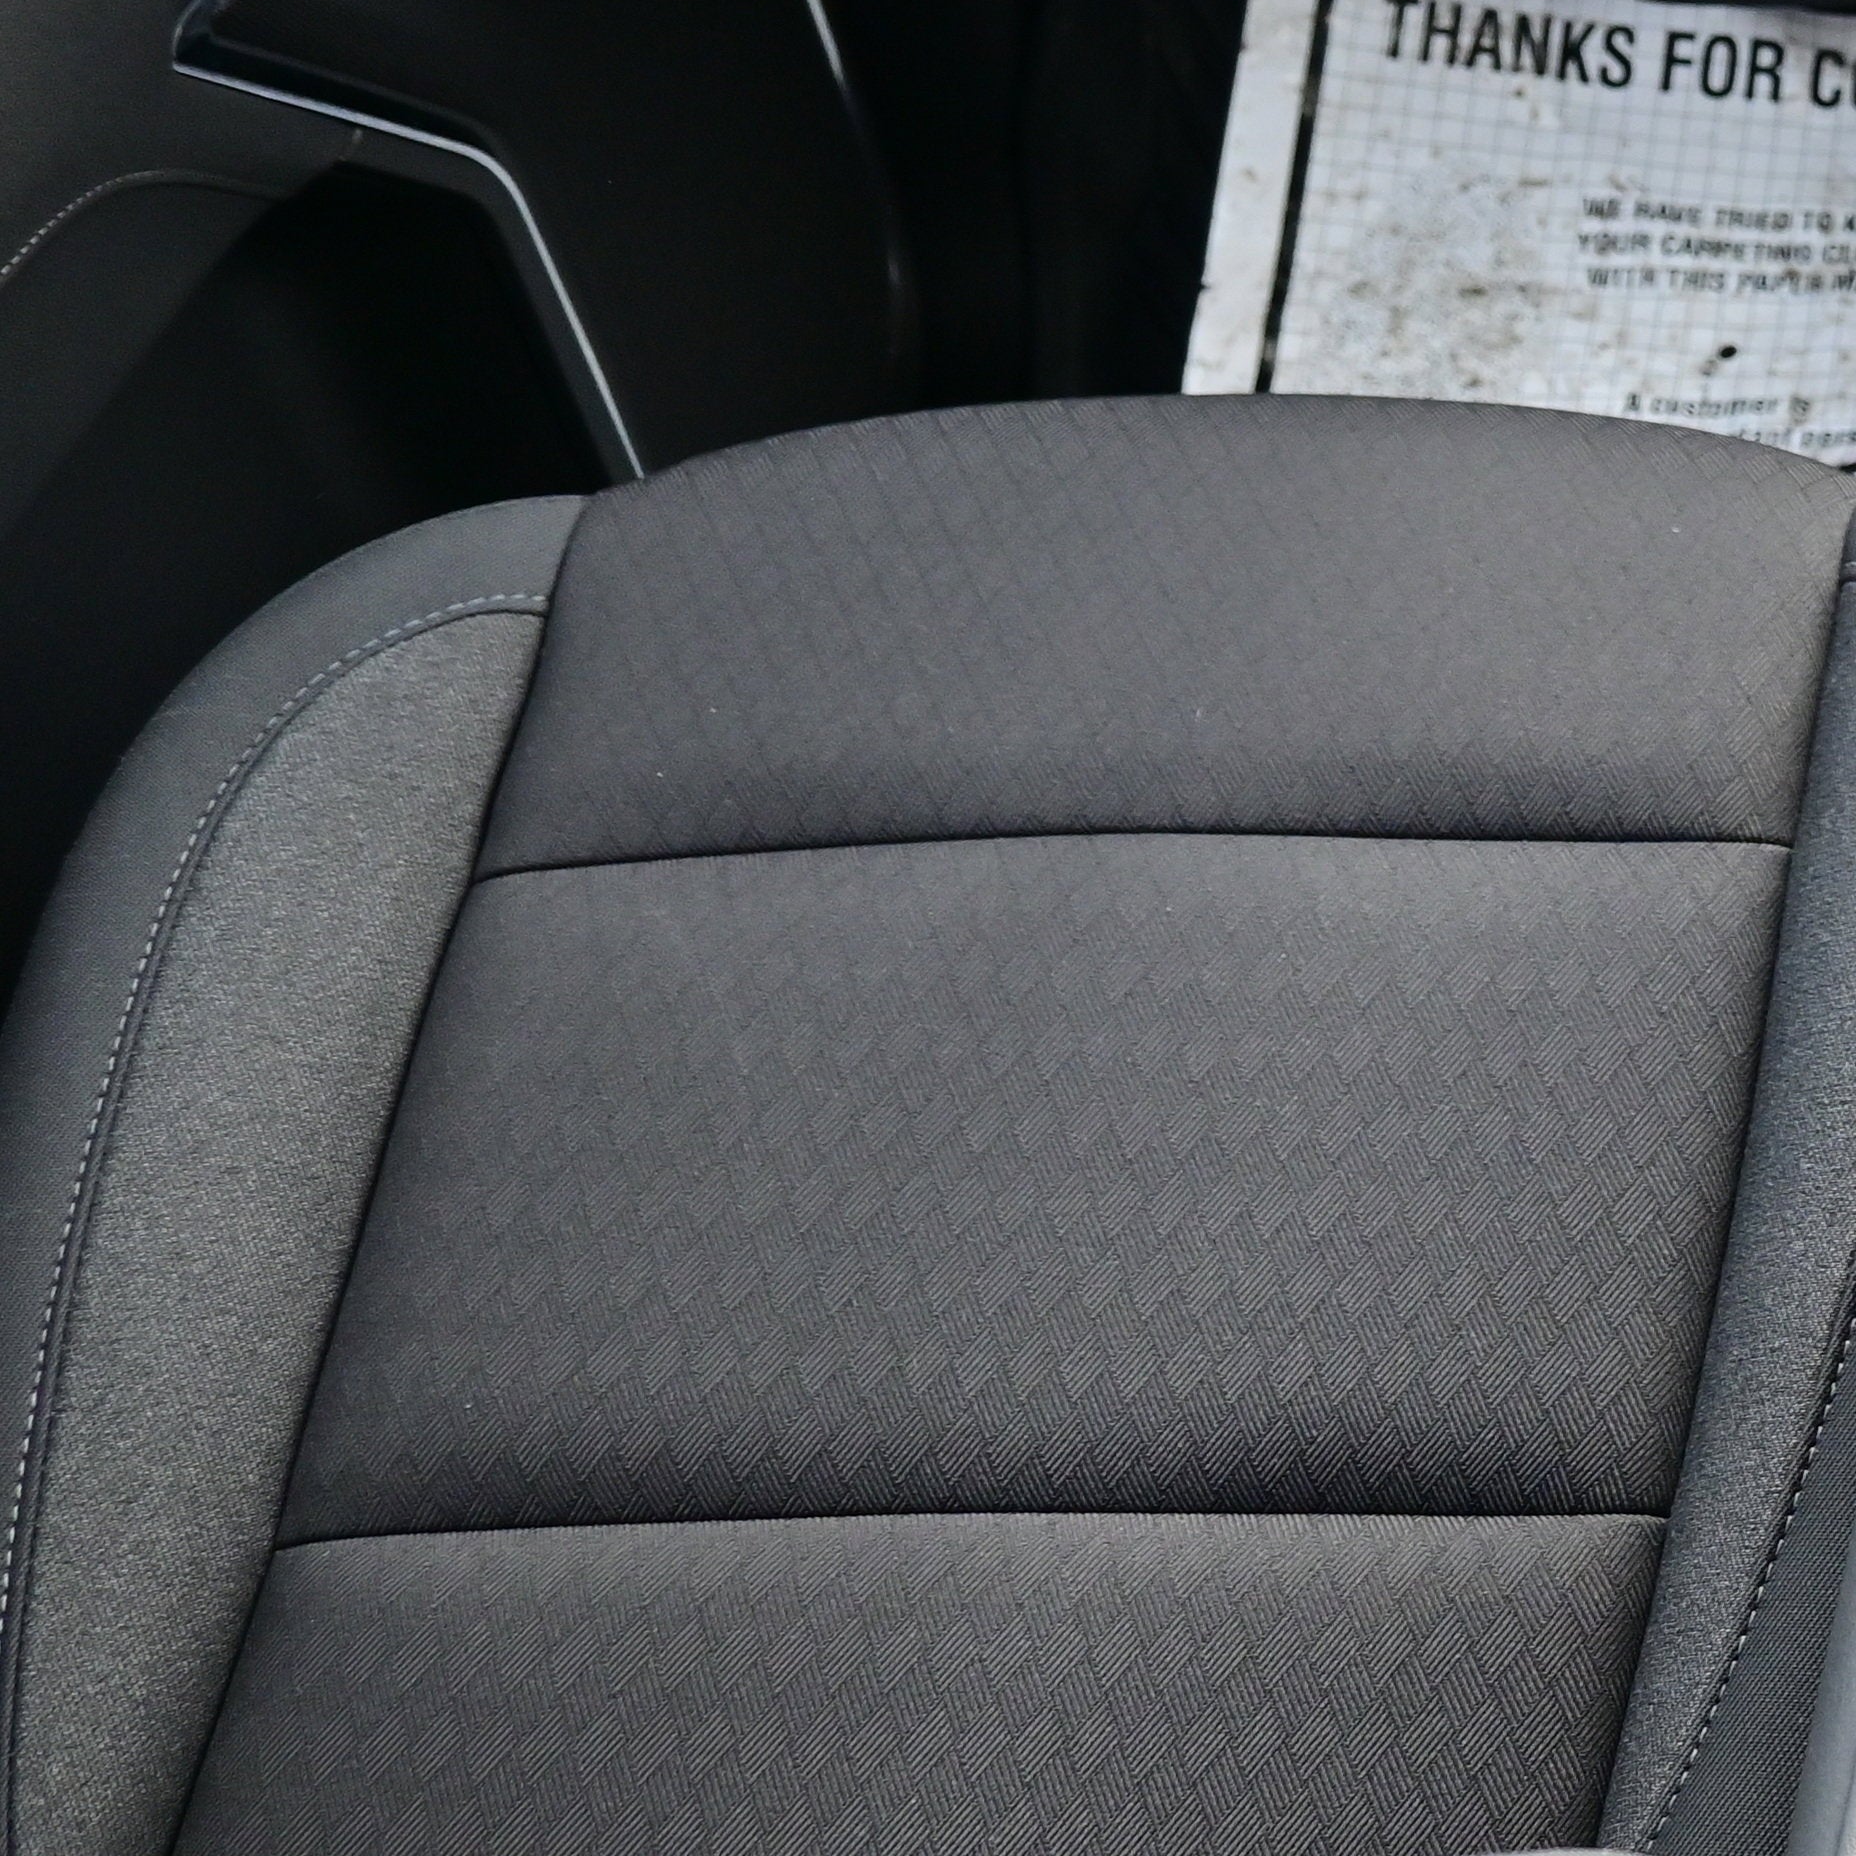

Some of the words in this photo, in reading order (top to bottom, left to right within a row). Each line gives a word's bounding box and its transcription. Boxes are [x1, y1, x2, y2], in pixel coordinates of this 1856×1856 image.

[1660, 28, 1786, 103] FOR
[1633, 200, 1701, 224] HAVE
[1714, 208, 1793, 232] TRIED
[1802, 210, 1834, 234] TO
[1668, 268, 1726, 292] THIS
